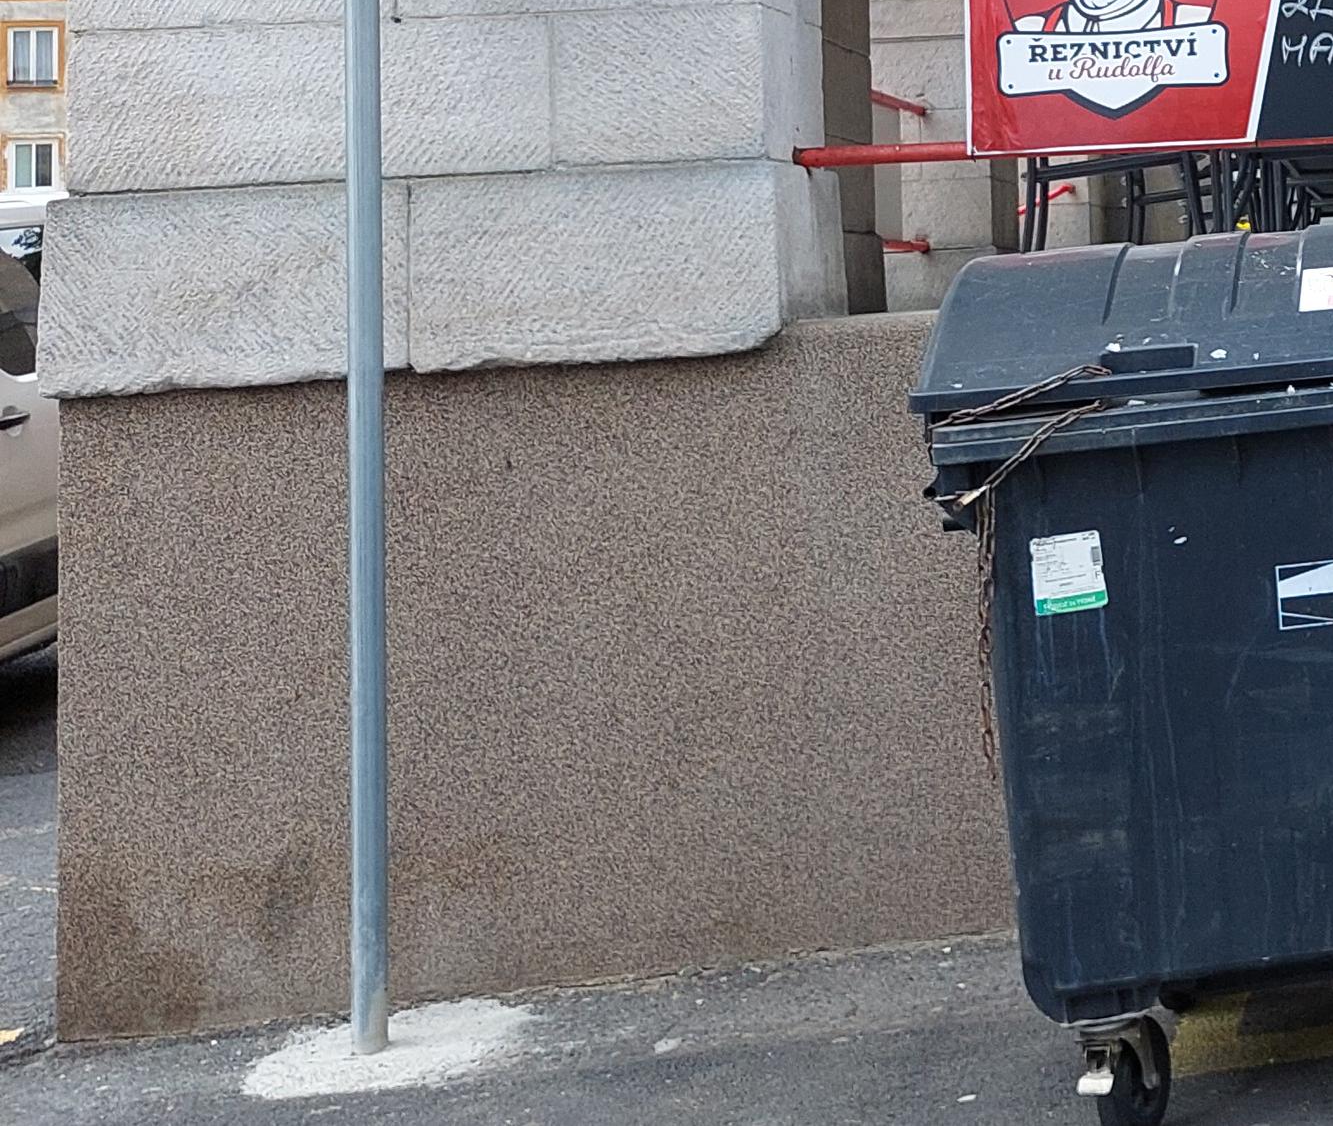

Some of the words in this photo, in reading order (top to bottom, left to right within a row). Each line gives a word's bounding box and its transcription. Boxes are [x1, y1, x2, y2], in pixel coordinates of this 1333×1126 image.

[1028, 31, 1198, 63] ŘEZNICTVÍ
[1048, 67, 1063, 81] u
[1069, 54, 1176, 83] Rudolfa
